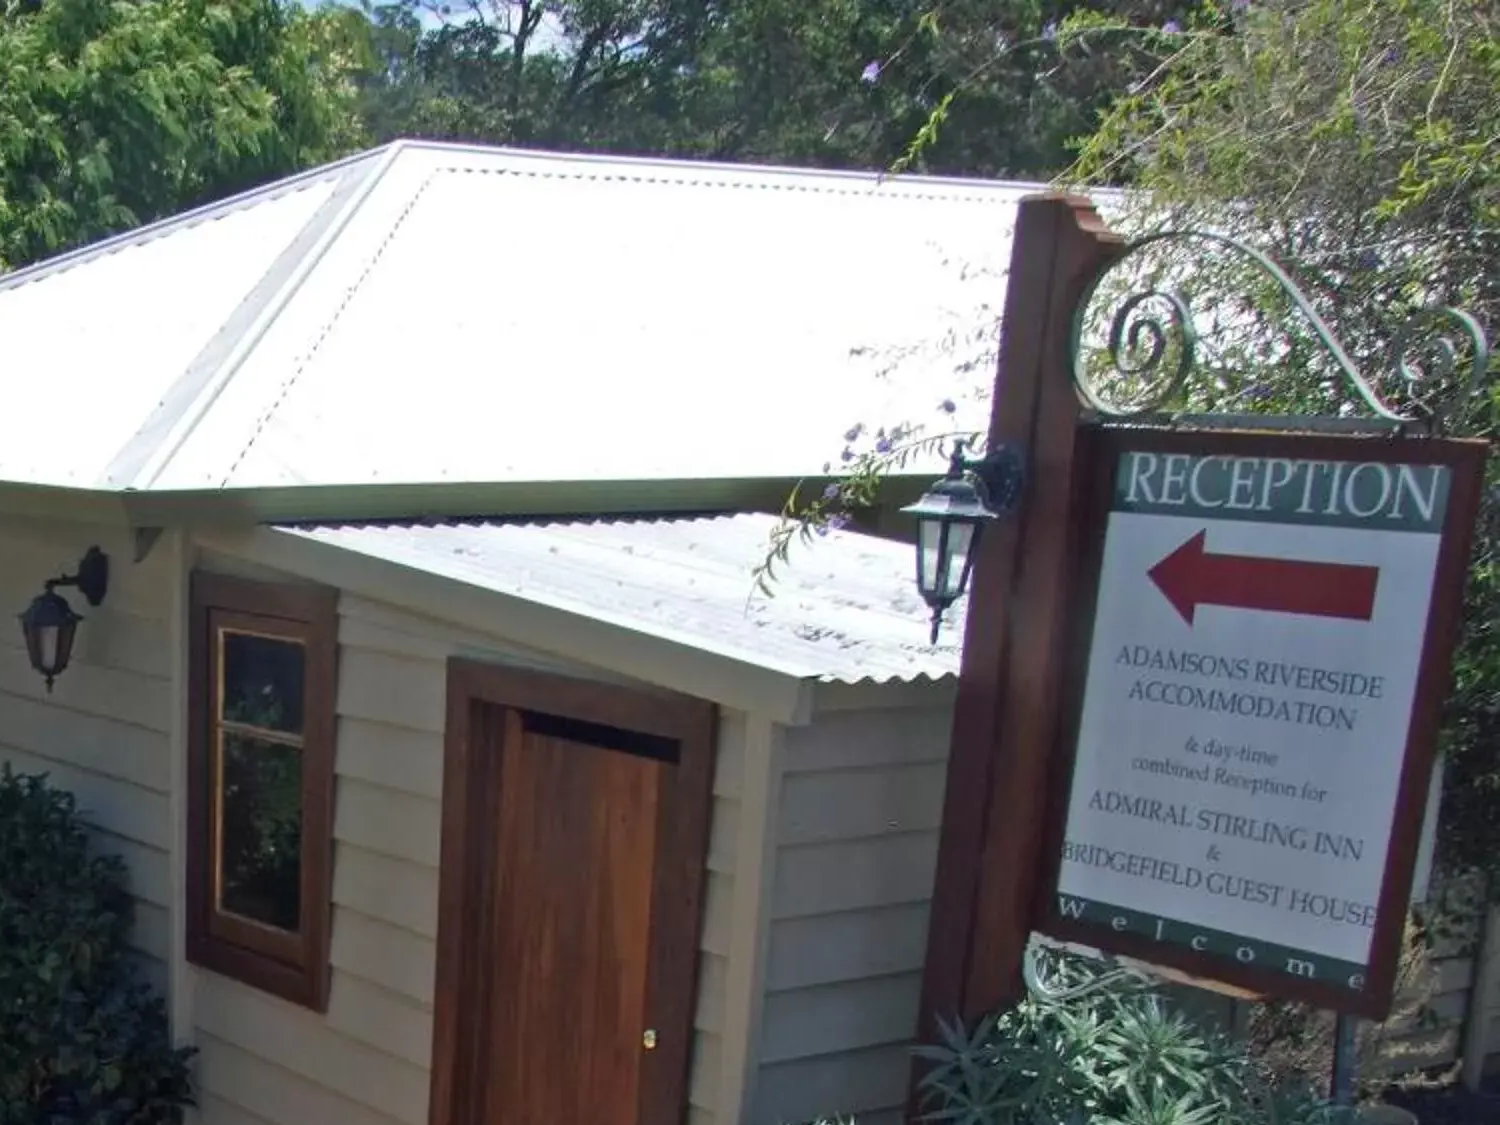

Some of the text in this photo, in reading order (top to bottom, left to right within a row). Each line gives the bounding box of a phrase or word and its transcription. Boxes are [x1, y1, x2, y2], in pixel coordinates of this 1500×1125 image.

[1124, 451, 1445, 521] RECEPTION
[1115, 645, 1385, 699] ADAMSONS RIVERSIDE
[1128, 680, 1357, 730] ACCOMMODATION
[1203, 739, 1278, 764] day-time
[1131, 756, 1328, 802] combined Reception for
[1088, 789, 1365, 862] ADMIRAL STIRLING INN
[1061, 840, 1376, 928] BRIDGEFIELD GUEST HOUSE
